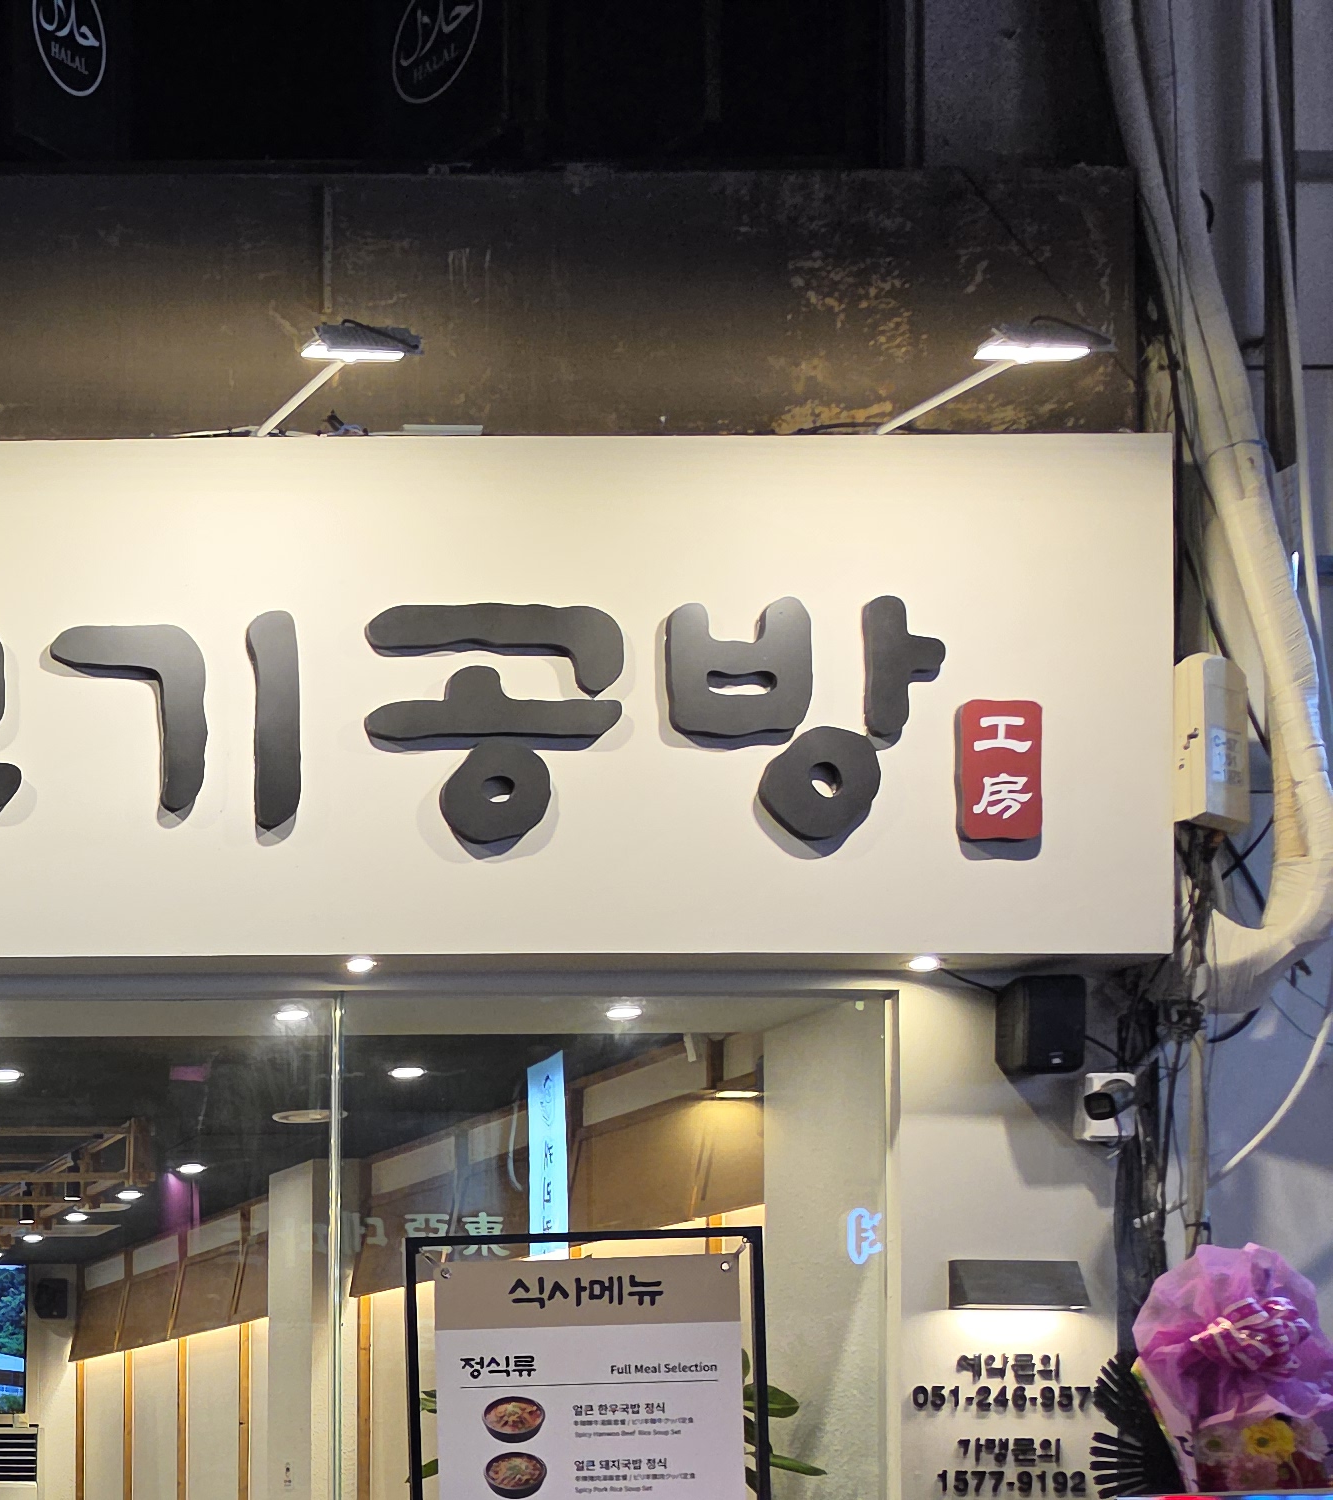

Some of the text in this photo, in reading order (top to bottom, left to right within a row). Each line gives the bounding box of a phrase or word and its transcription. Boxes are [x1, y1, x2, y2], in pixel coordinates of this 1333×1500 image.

[50, 41, 89, 75] HALAL
[412, 42, 459, 83] HALAL
[972, 715, 1033, 820] 工房
[507, 1274, 664, 1309] 식사메뉴
[460, 1354, 537, 1379] 정식류
[610, 1361, 718, 1375] Full Meal Selection
[573, 1404, 594, 1417] 얼큰
[644, 1402, 666, 1414] 정식
[912, 1385, 1093, 1413] 051-246-957
[574, 1460, 595, 1472] 얼큰
[646, 1458, 667, 1470] 정식
[956, 1437, 1061, 1466] 가맹문의
[937, 1469, 1086, 1498] 1577-9192
